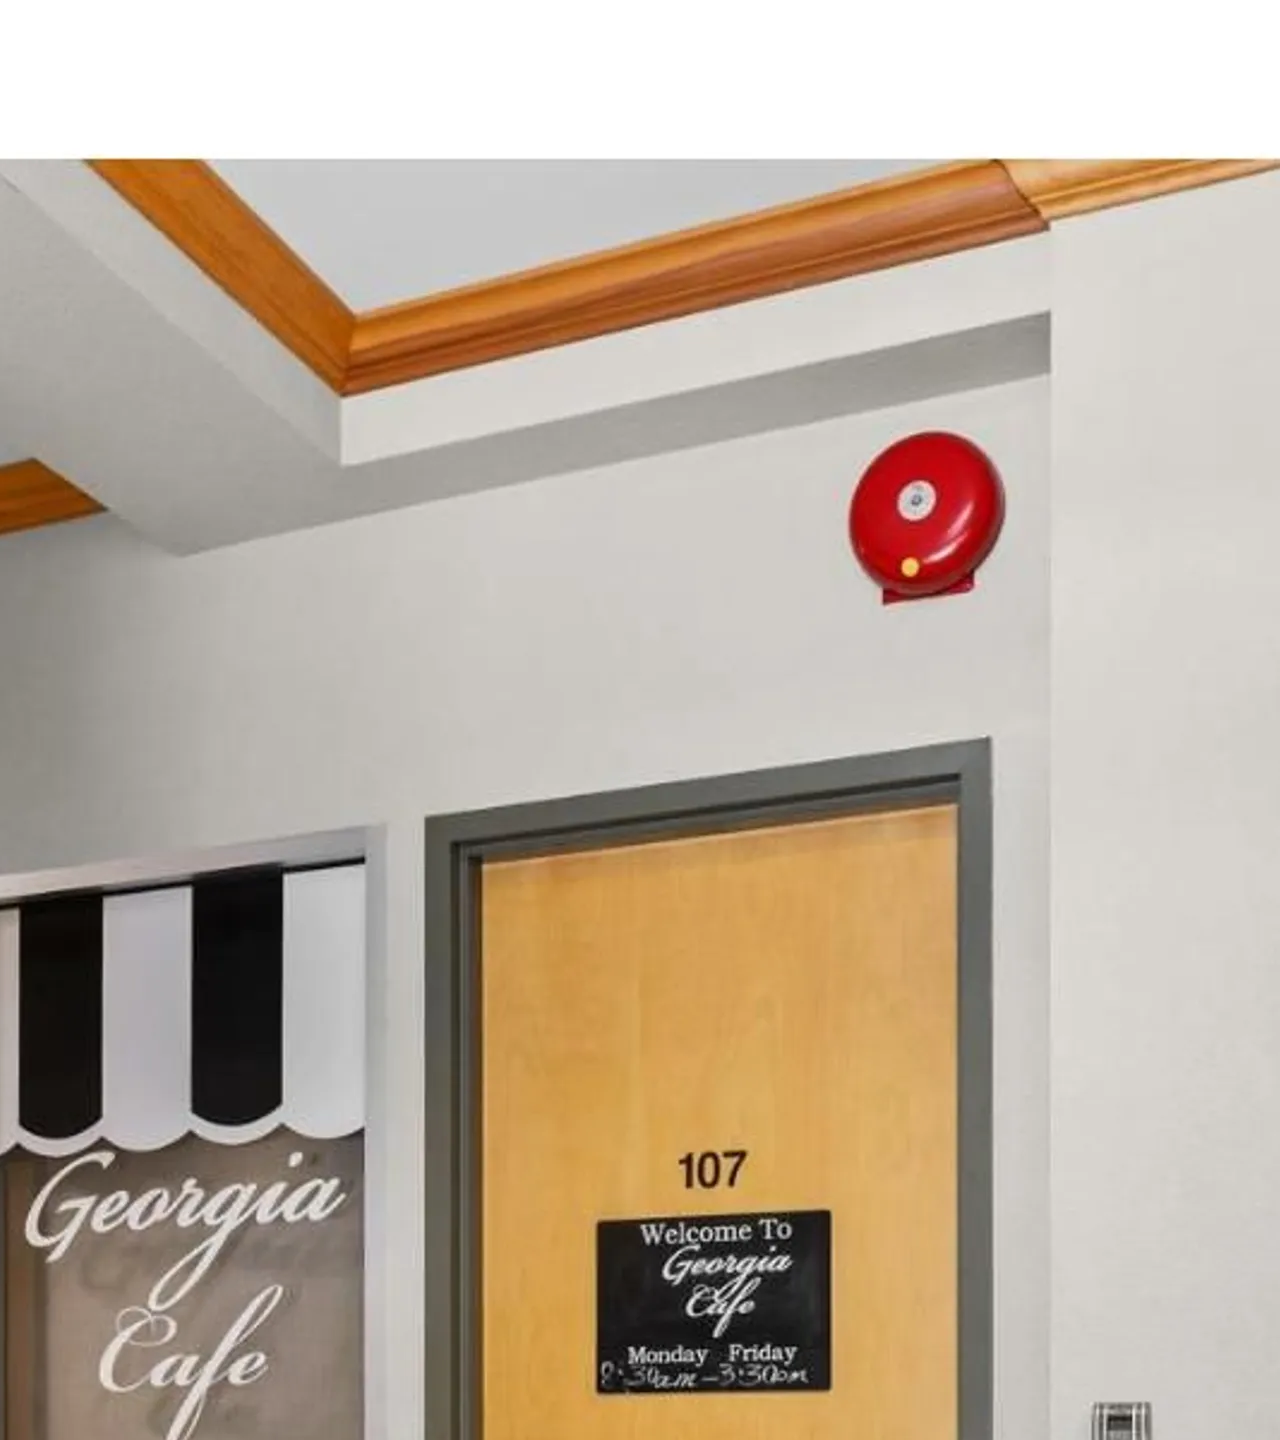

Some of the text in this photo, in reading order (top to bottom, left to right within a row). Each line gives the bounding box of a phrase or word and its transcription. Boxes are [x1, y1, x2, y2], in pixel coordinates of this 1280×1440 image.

[679, 1150, 747, 1189] 107
[24, 1151, 347, 1312] Georgia
[640, 1218, 794, 1246] Welcome To
[661, 1244, 793, 1303] Georgia
[685, 1276, 762, 1339] Cafe
[627, 1342, 799, 1368] Monday Friday
